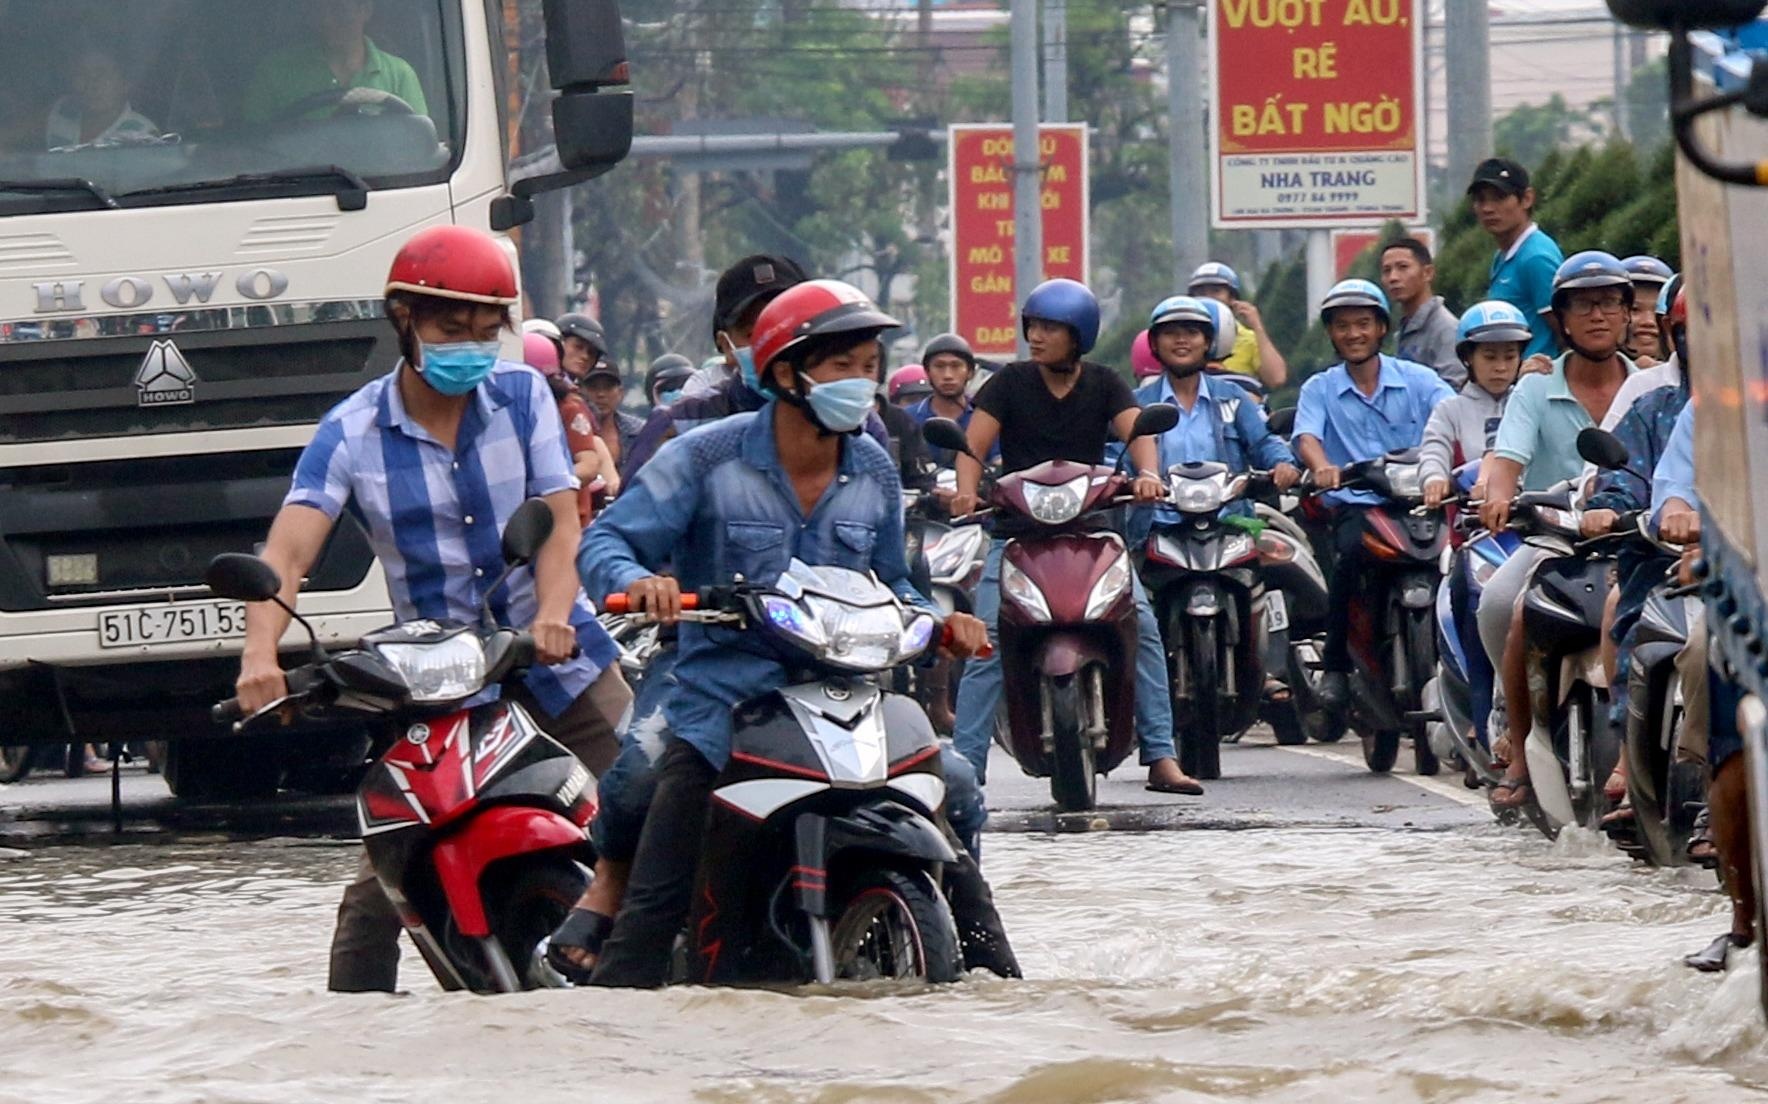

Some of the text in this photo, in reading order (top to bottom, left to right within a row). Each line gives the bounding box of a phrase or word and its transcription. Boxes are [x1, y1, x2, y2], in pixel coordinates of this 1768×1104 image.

[1232, 93, 1400, 136] BẤT NGỜ
[1261, 170, 1376, 189] NHA TRANG
[1277, 193, 1306, 203] 0977
[1047, 246, 1070, 263] XE
[33, 268, 288, 313] HOWO
[143, 390, 189, 402] HOWO
[105, 605, 246, 642] 51C-751.53
